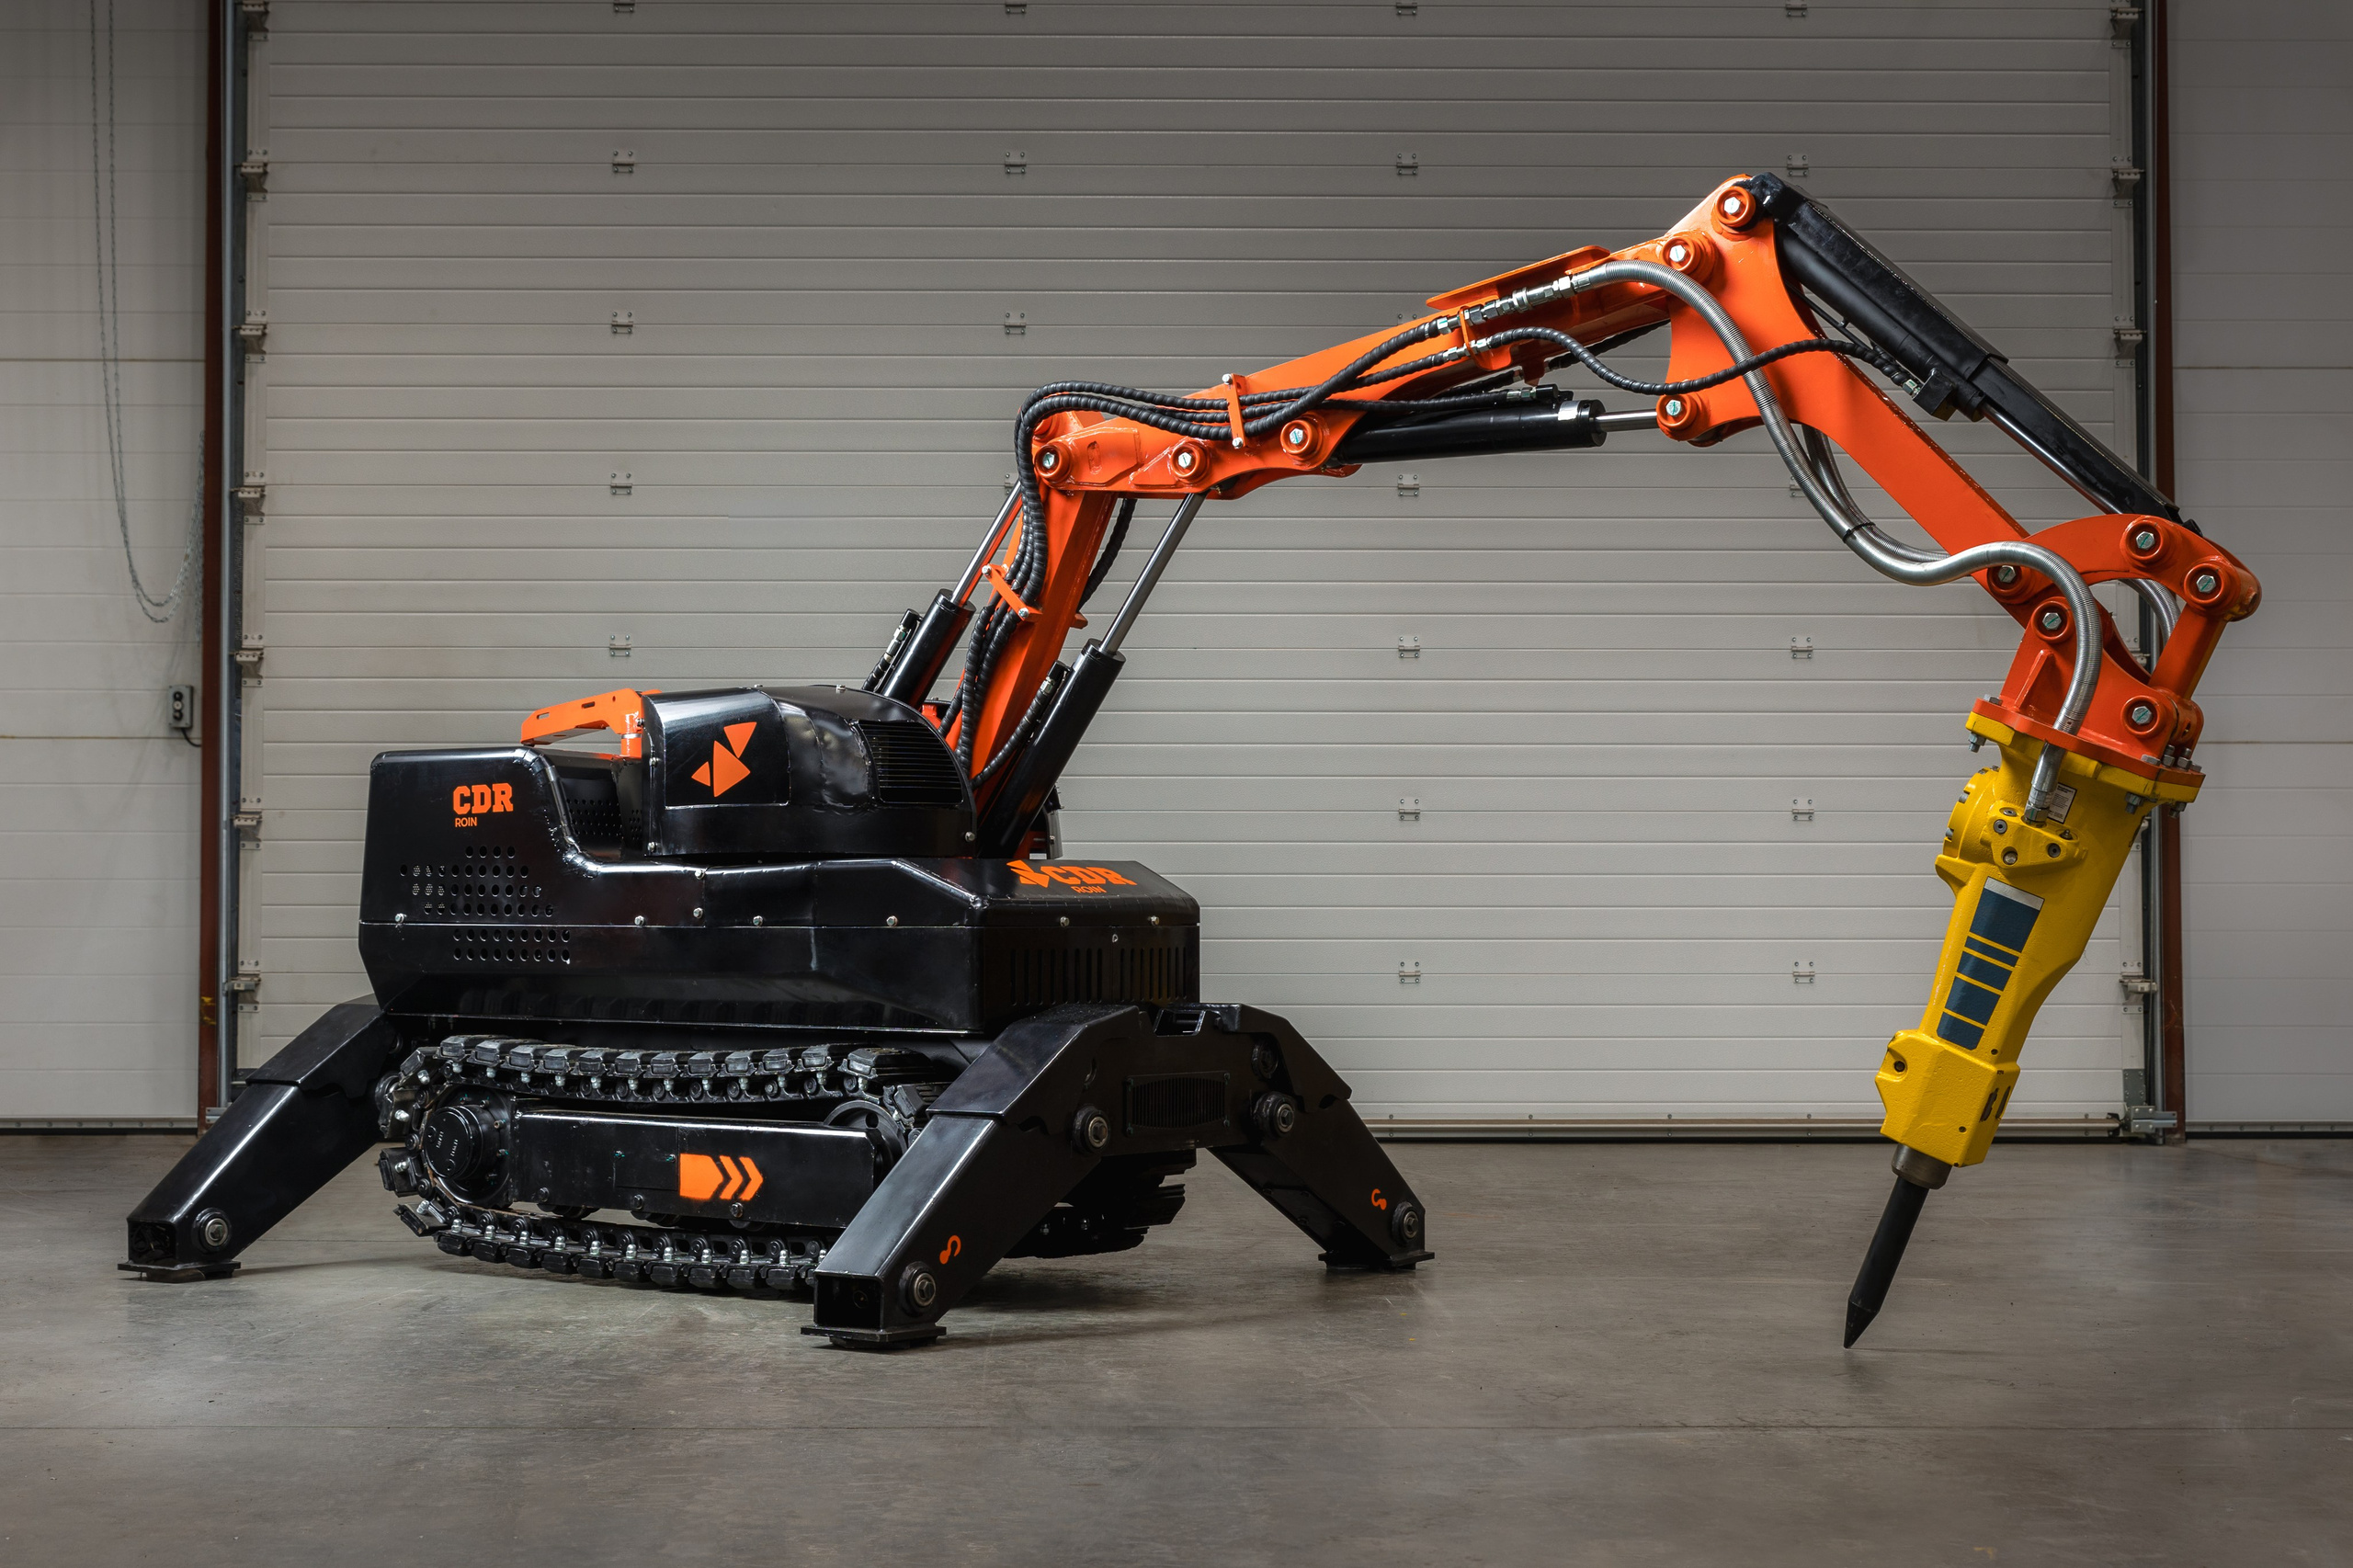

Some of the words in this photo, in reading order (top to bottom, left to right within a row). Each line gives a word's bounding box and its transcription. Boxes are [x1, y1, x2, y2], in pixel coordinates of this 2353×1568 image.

[453, 782, 513, 814] CDR
[455, 816, 477, 827] ROIN
[1040, 866, 1137, 884] CDR
